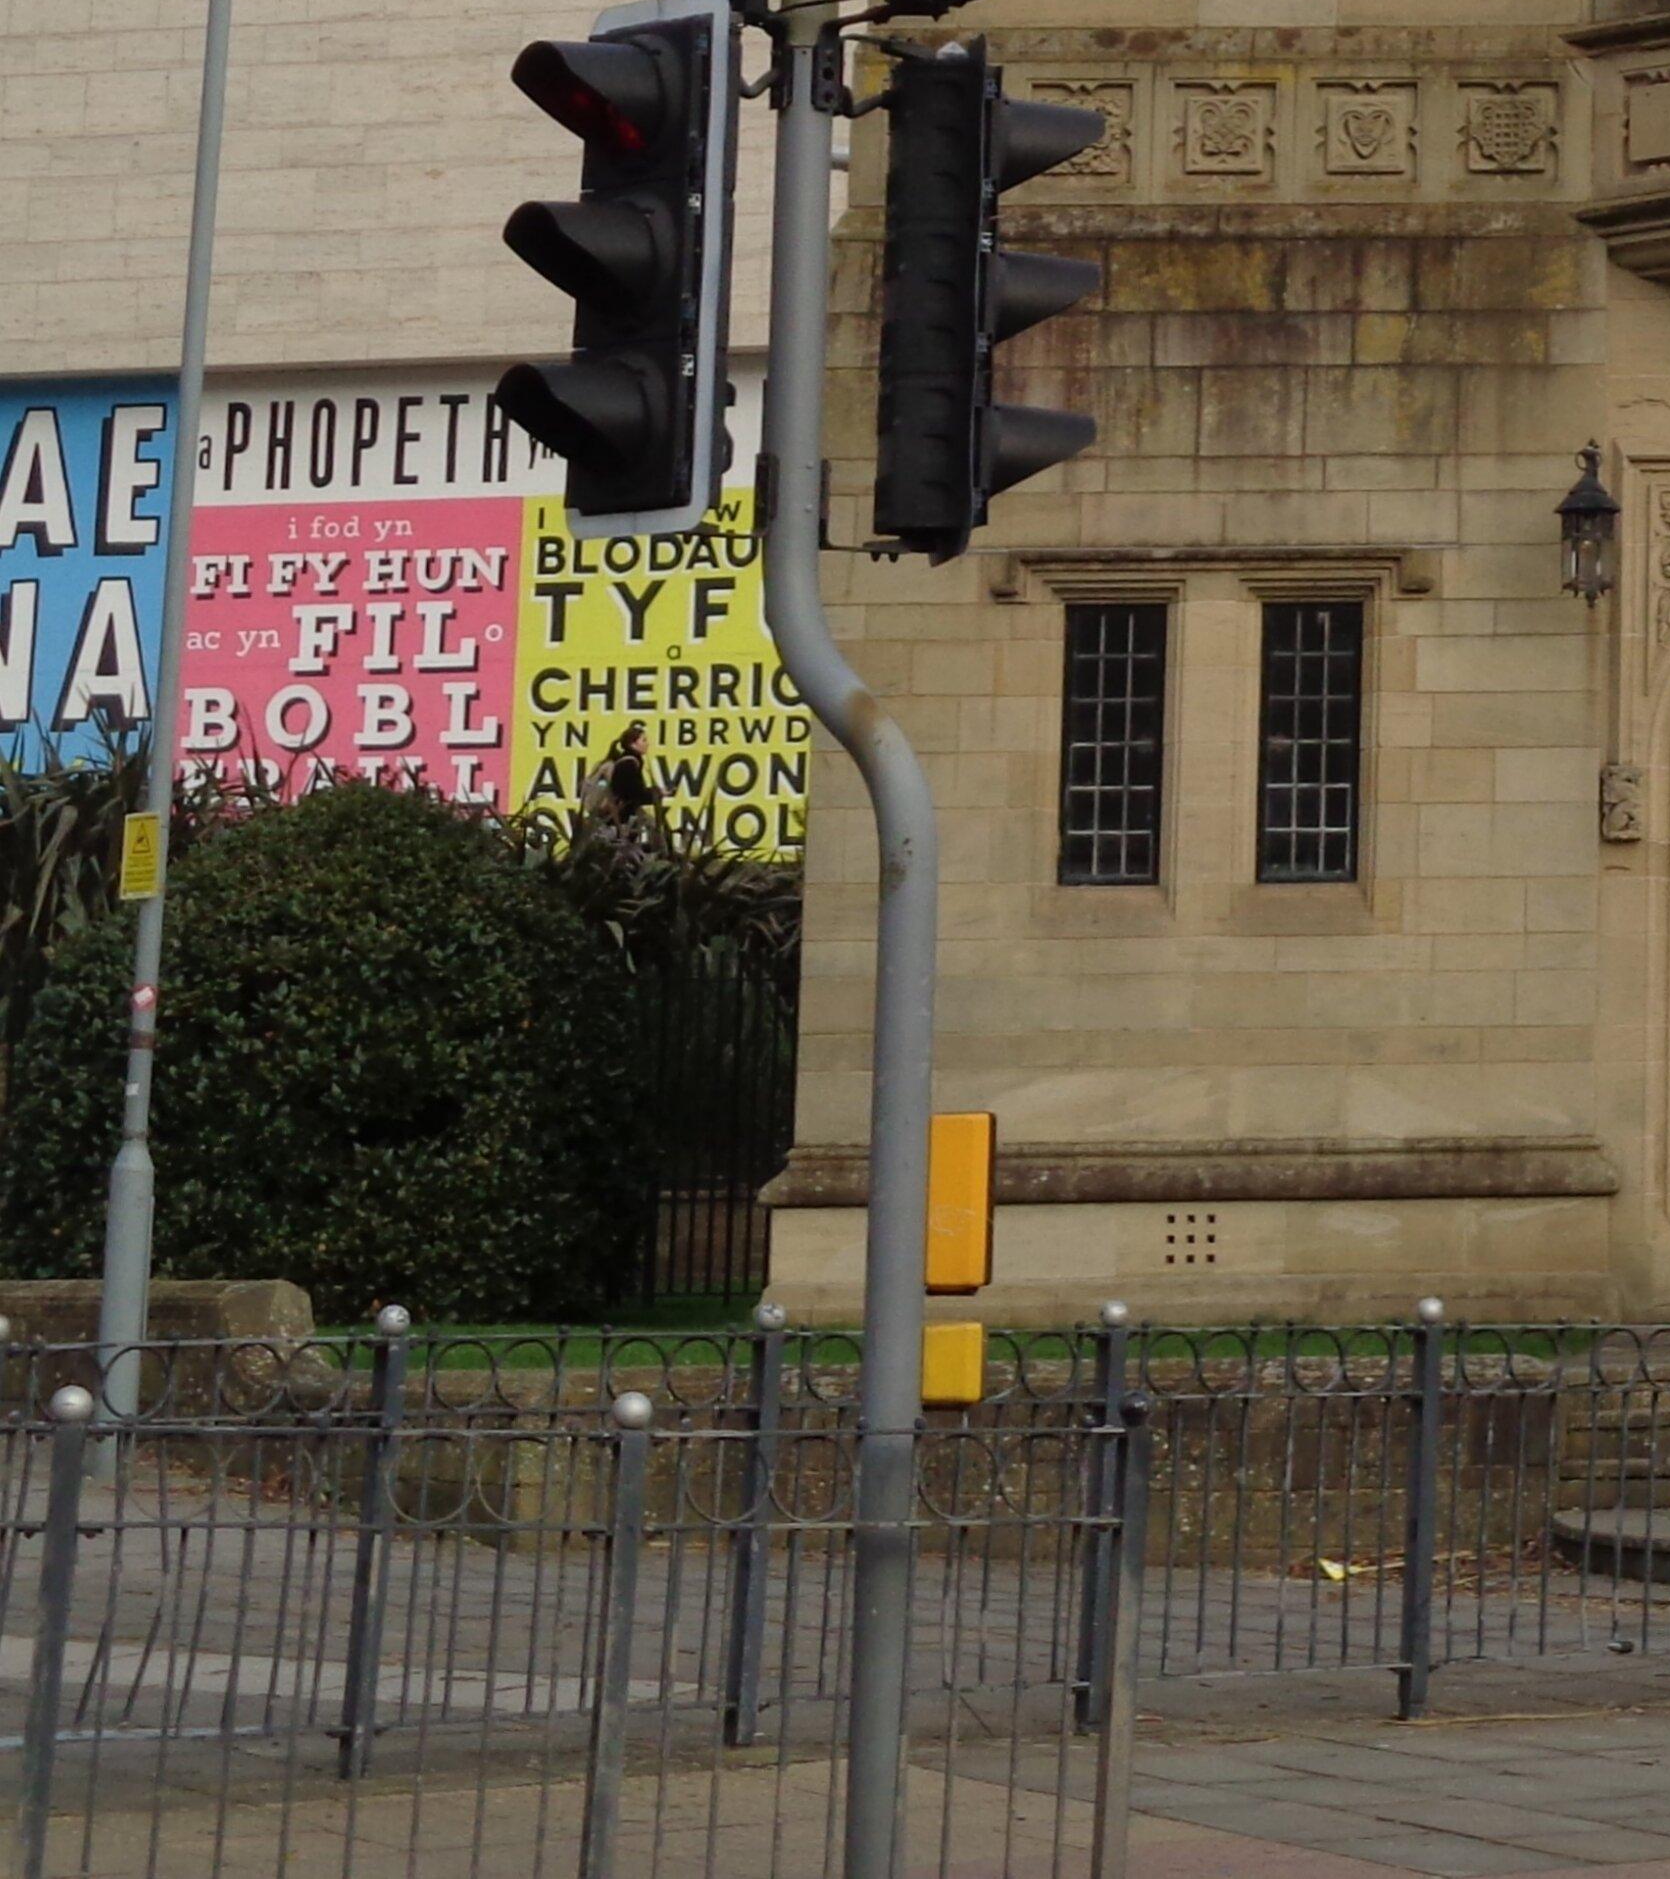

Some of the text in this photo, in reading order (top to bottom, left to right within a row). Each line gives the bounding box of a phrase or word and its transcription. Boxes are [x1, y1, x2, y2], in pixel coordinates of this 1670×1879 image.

[199, 435, 213, 470] a
[223, 393, 512, 491] PHOPETH
[287, 516, 414, 543] i fod yn
[190, 546, 508, 600] FI FY HUN
[186, 600, 504, 676] ac yn FIL o
[666, 644, 682, 661] a
[180, 681, 502, 754] BOBL
[531, 720, 590, 749] YN
